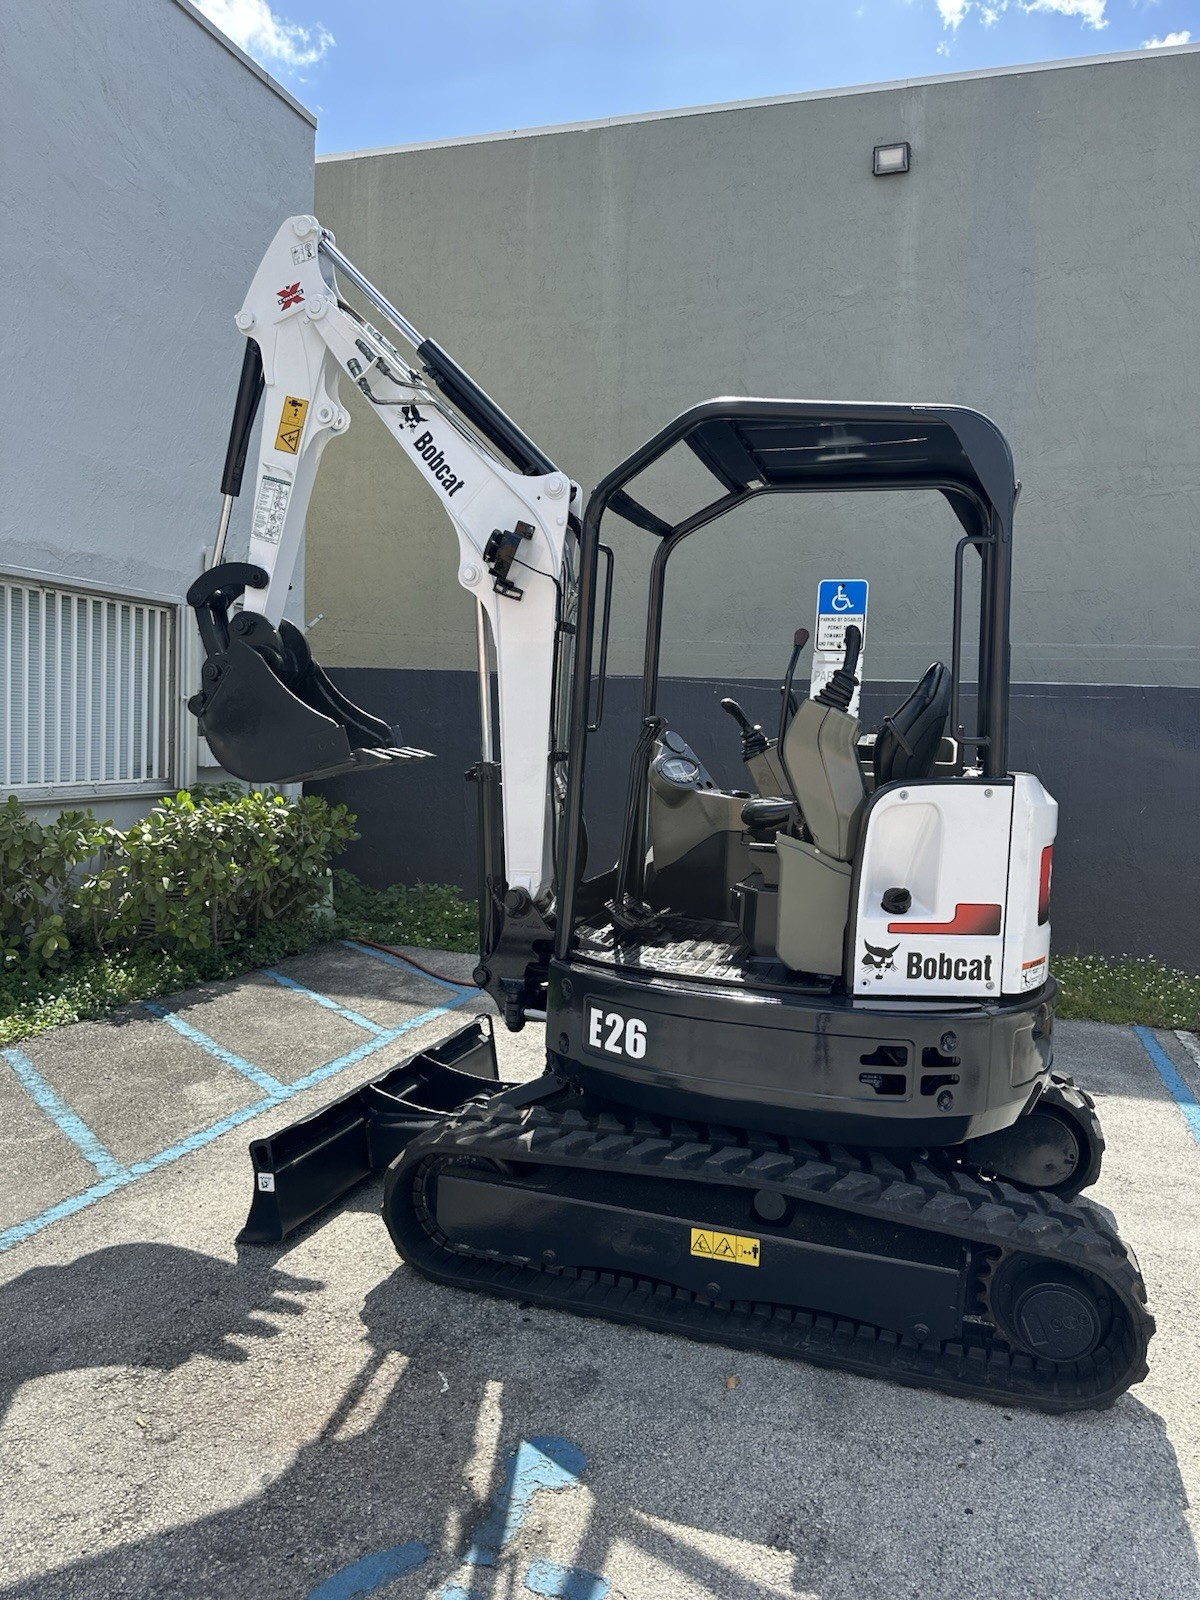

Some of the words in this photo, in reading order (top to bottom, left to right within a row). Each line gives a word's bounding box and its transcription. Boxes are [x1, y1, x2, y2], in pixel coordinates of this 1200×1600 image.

[413, 430, 465, 498] Bobcat
[906, 952, 992, 981] Bobcat
[589, 1007, 648, 1059] E26
